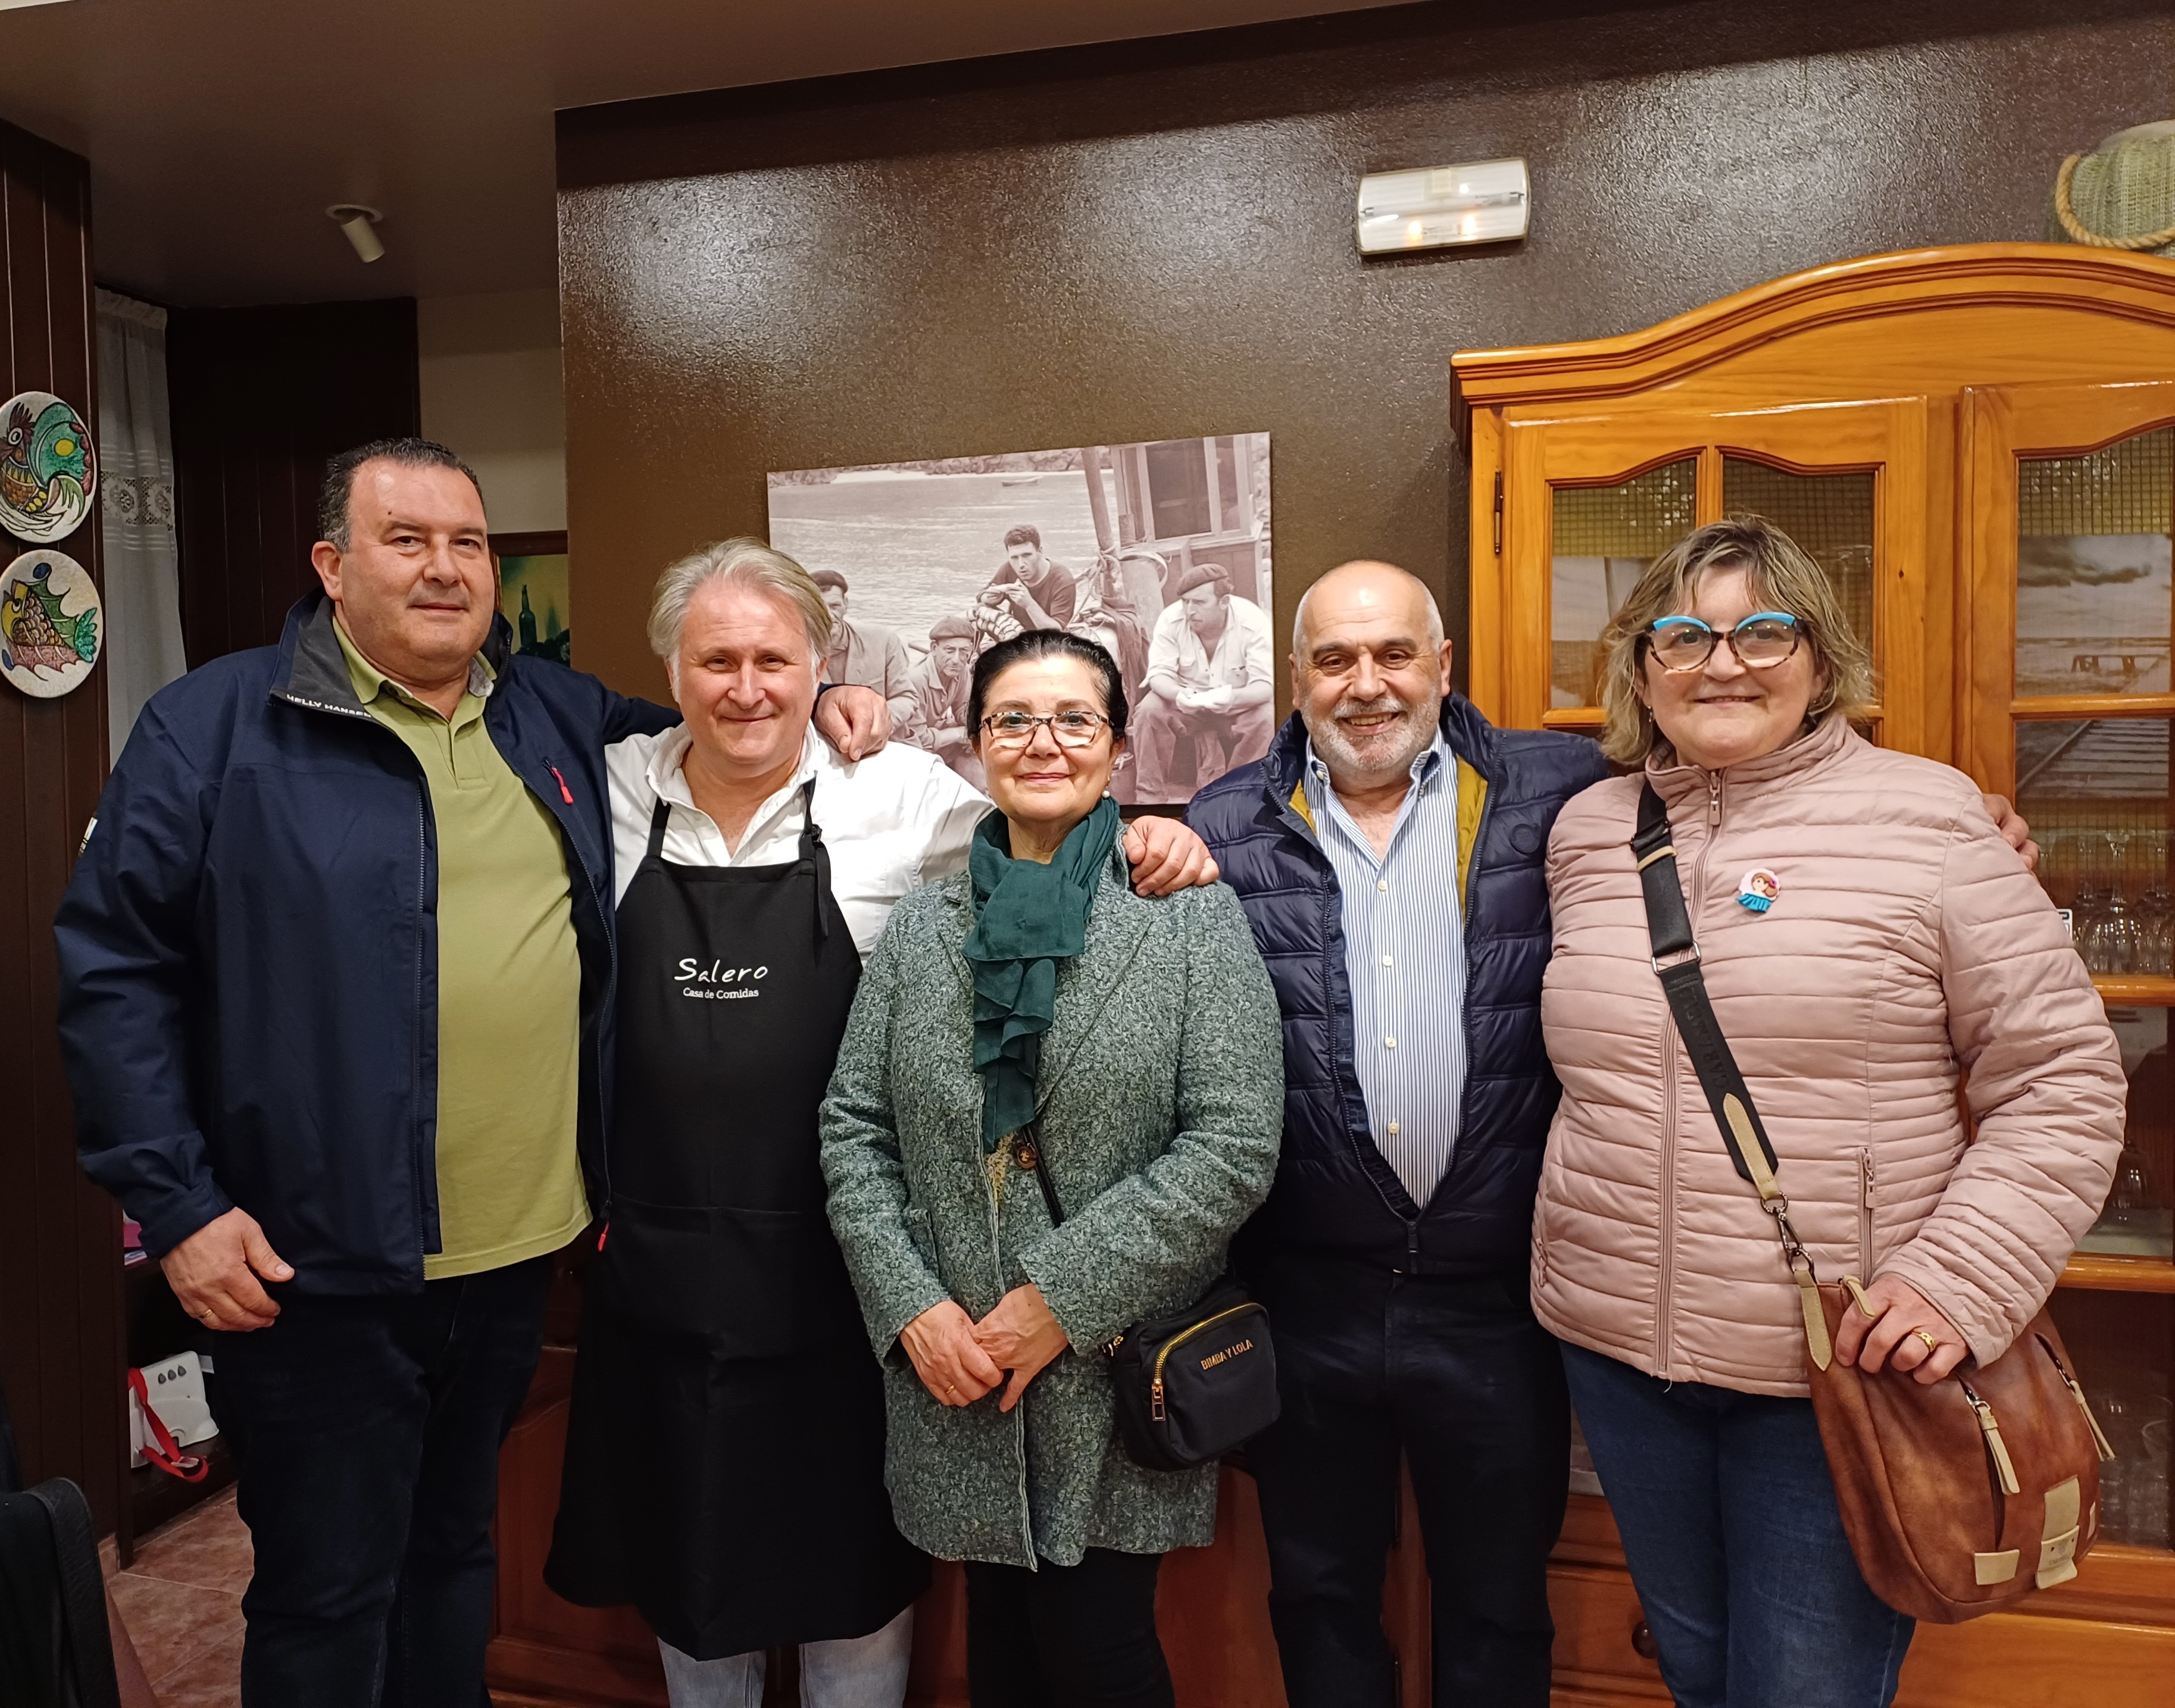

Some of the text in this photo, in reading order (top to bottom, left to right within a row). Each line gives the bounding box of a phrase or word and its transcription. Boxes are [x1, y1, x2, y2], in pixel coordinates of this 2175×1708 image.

[286, 693, 322, 708] HELLY
[674, 958, 768, 983] Salero
[683, 987, 760, 1000] Casa de Comidas
[1201, 1339, 1254, 1371] BIMBA Y LOLA
